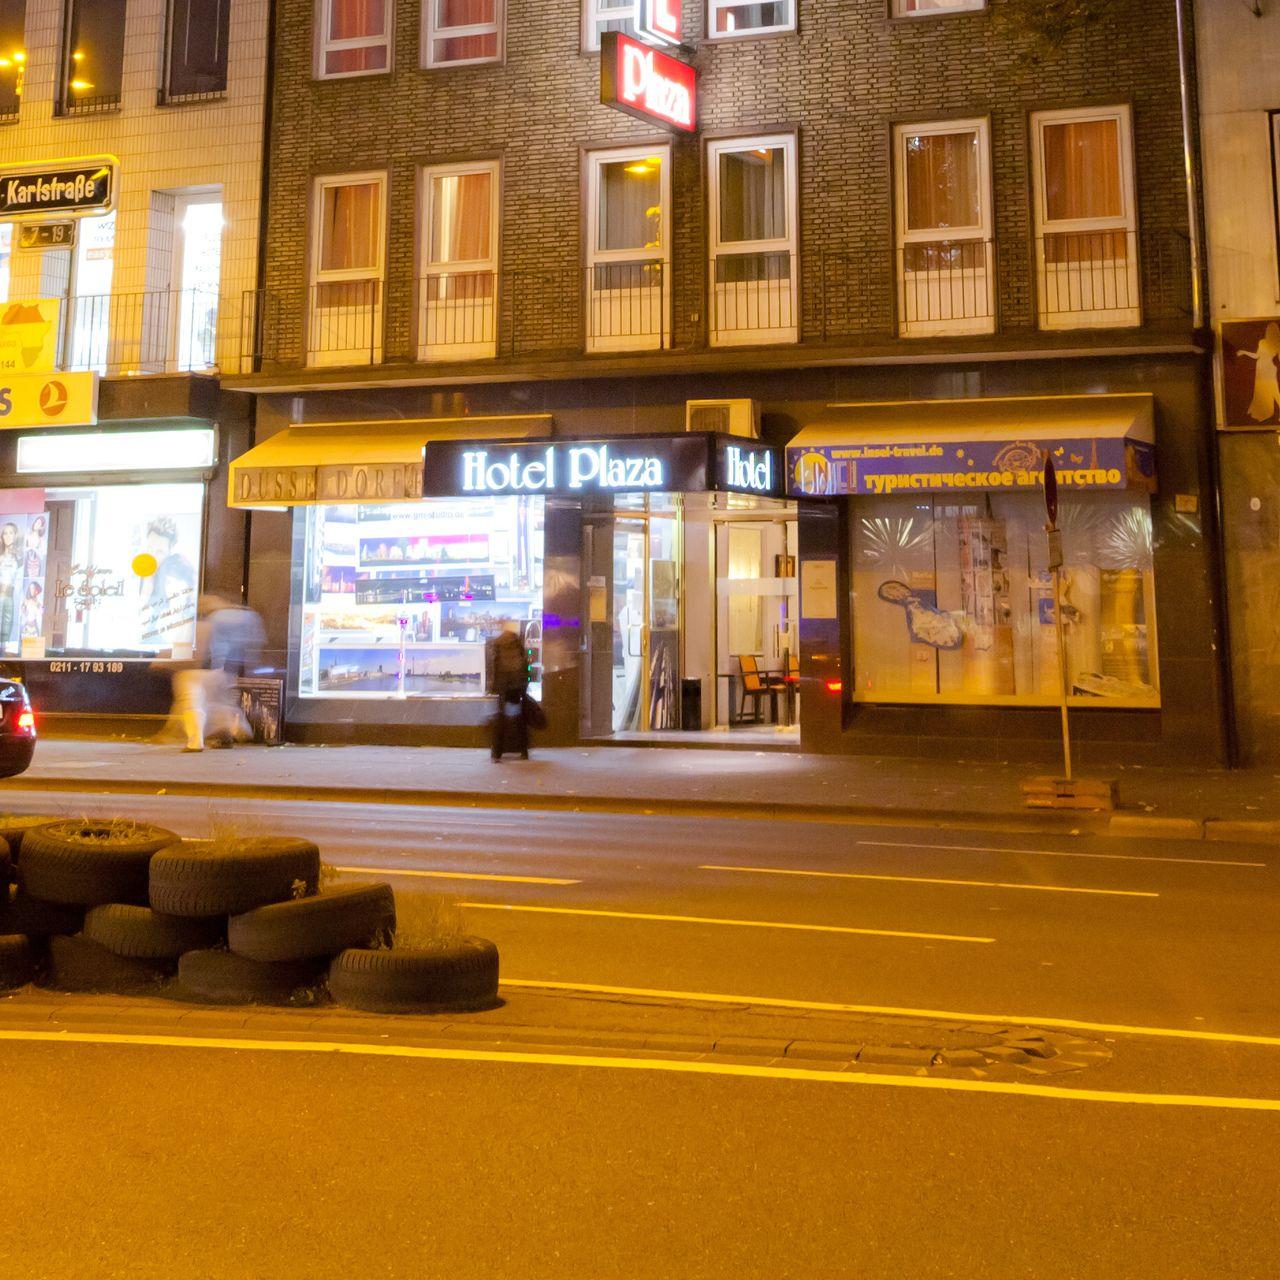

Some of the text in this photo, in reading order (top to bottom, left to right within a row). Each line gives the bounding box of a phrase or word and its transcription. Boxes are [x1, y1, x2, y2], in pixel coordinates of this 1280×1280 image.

[622, 43, 692, 126] Plaza
[6, 174, 96, 204] Karlstraße
[51, 225, 65, 243] 19
[462, 445, 664, 490] Hotel Plaza
[726, 446, 772, 491] Hotel
[863, 470, 1013, 494] туристическое
[50, 661, 71, 673] 0211
[80, 661, 89, 673] 17
